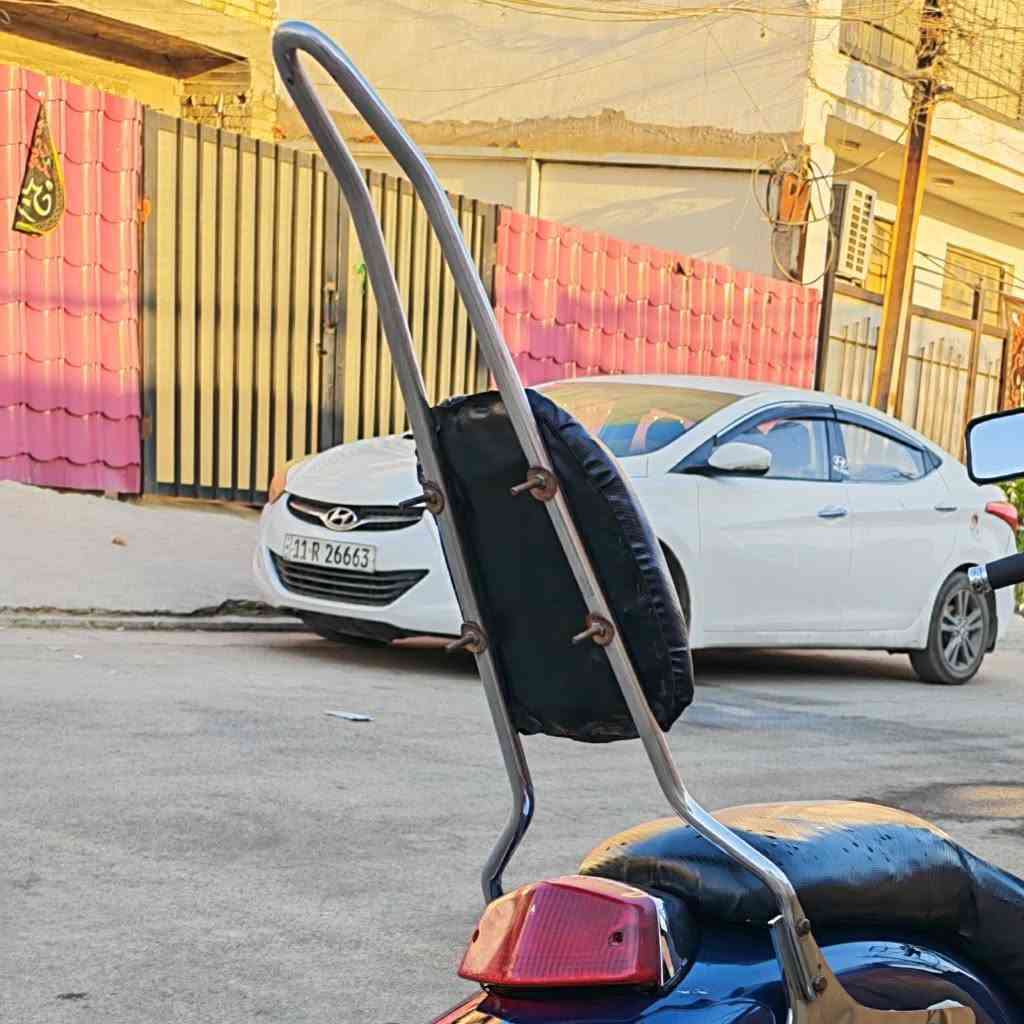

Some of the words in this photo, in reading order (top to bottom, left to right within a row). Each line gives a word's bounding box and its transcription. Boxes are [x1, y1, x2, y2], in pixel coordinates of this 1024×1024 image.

[293, 538, 307, 560] 11
[311, 541, 320, 561] R
[324, 543, 370, 568] 26663
